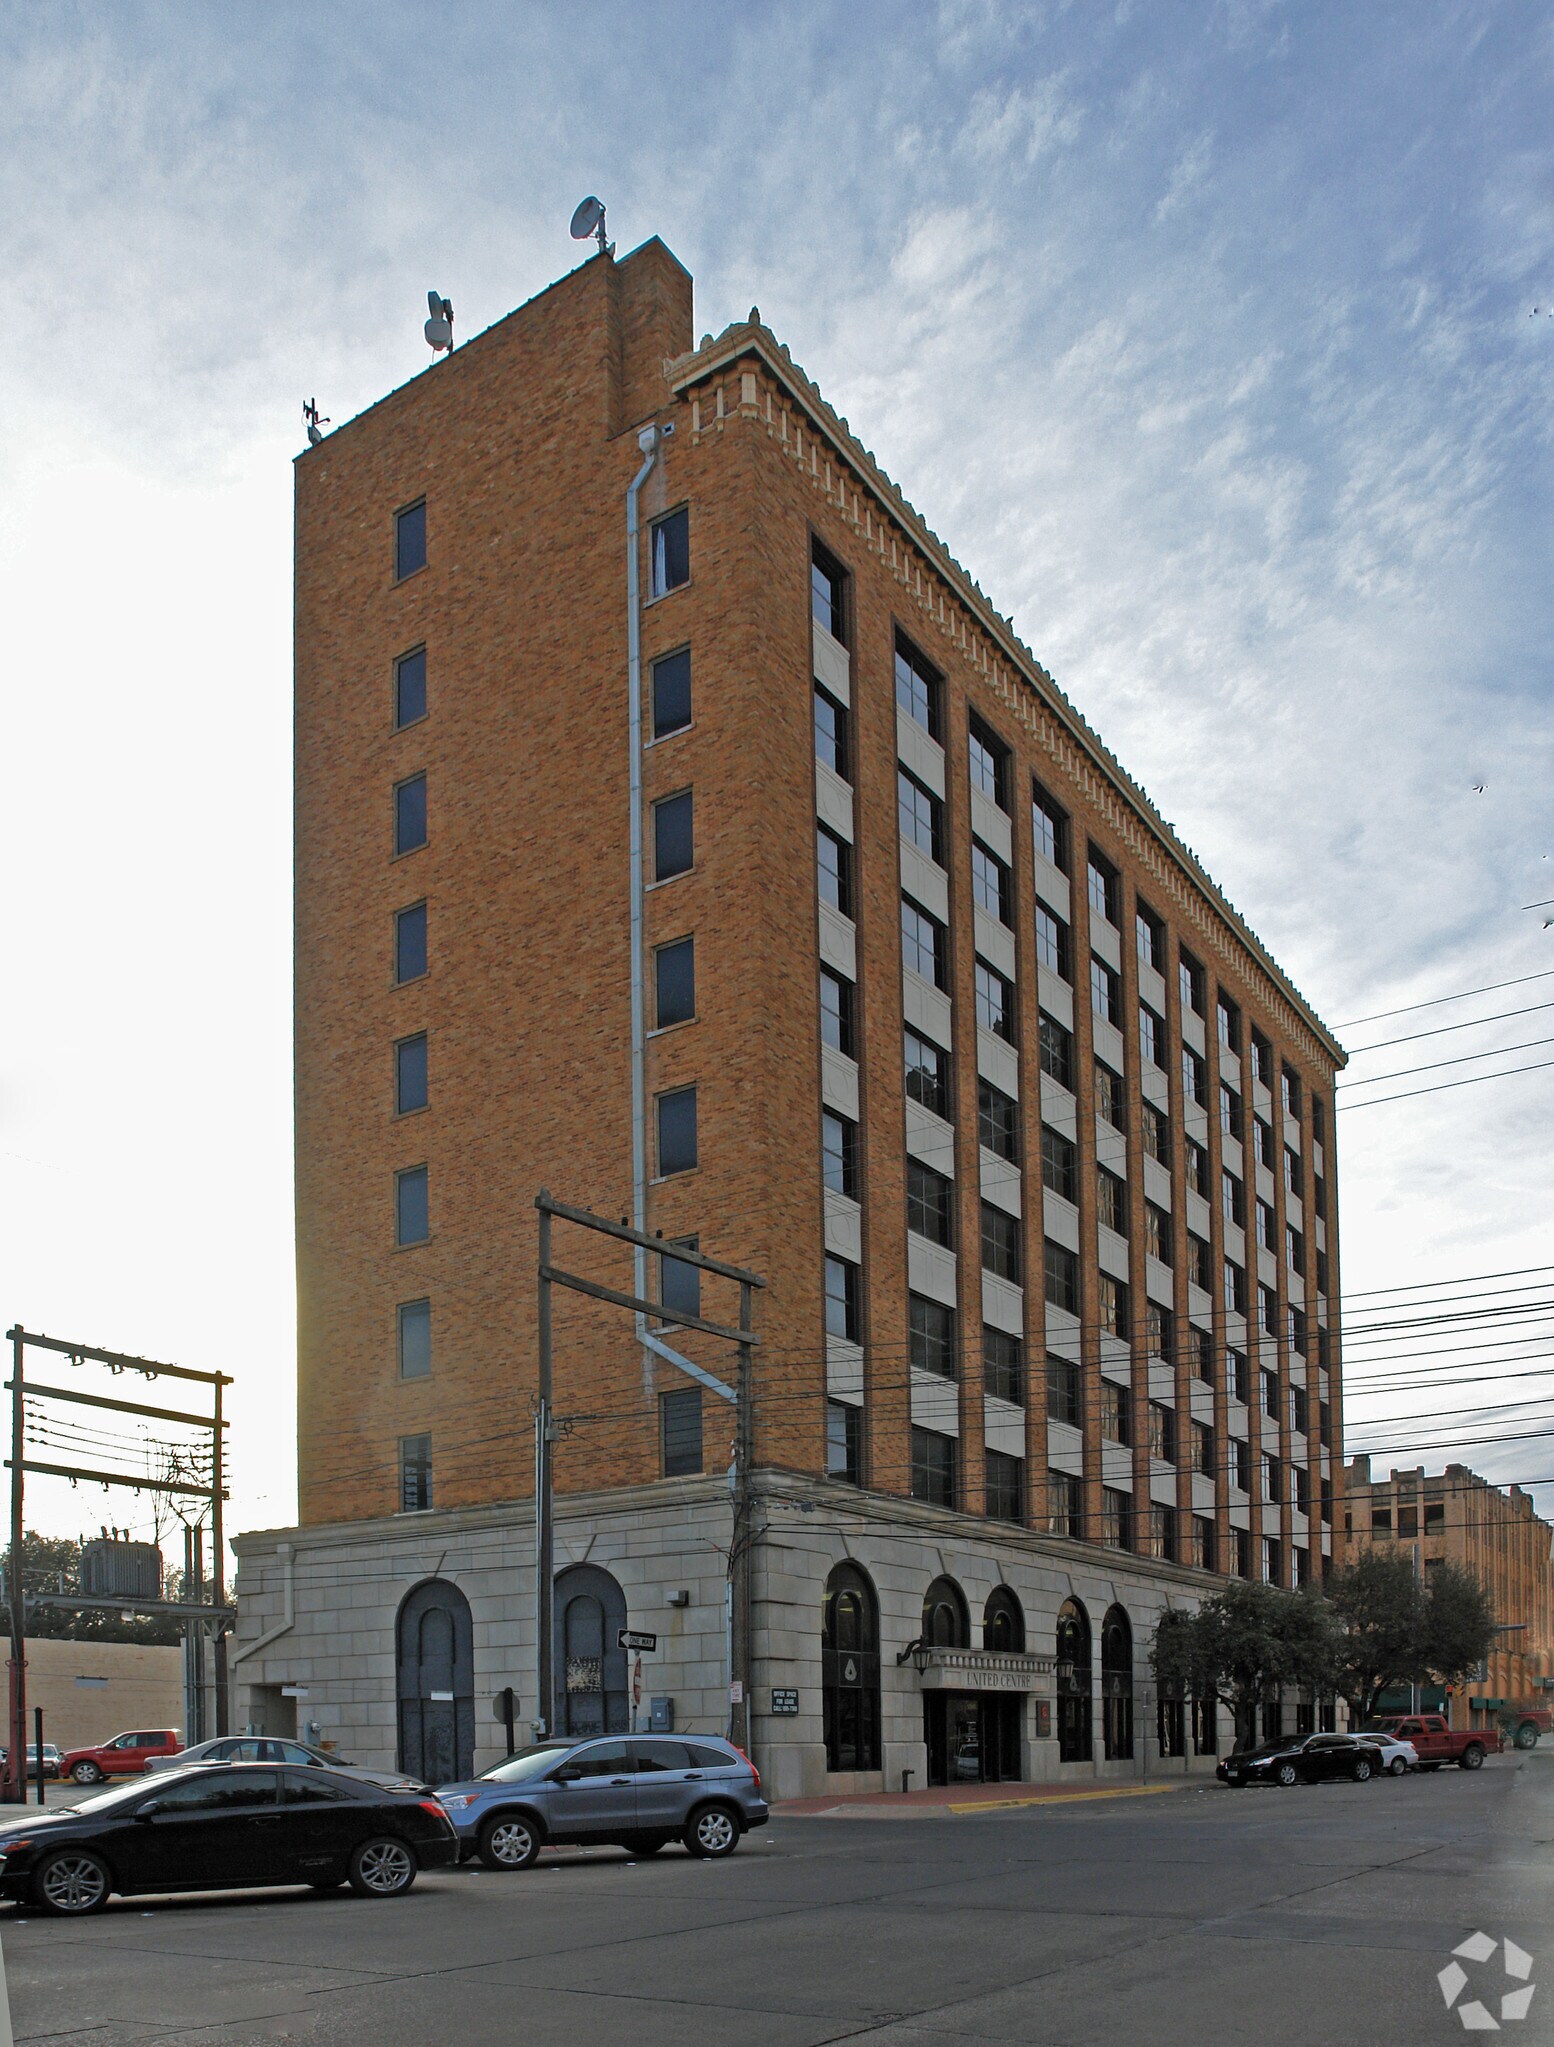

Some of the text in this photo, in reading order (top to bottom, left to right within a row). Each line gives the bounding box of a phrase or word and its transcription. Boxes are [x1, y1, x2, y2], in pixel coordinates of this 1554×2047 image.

[630, 1636, 653, 1646] ONE WAY
[967, 1671, 1031, 1688] UNITED CENTRE
